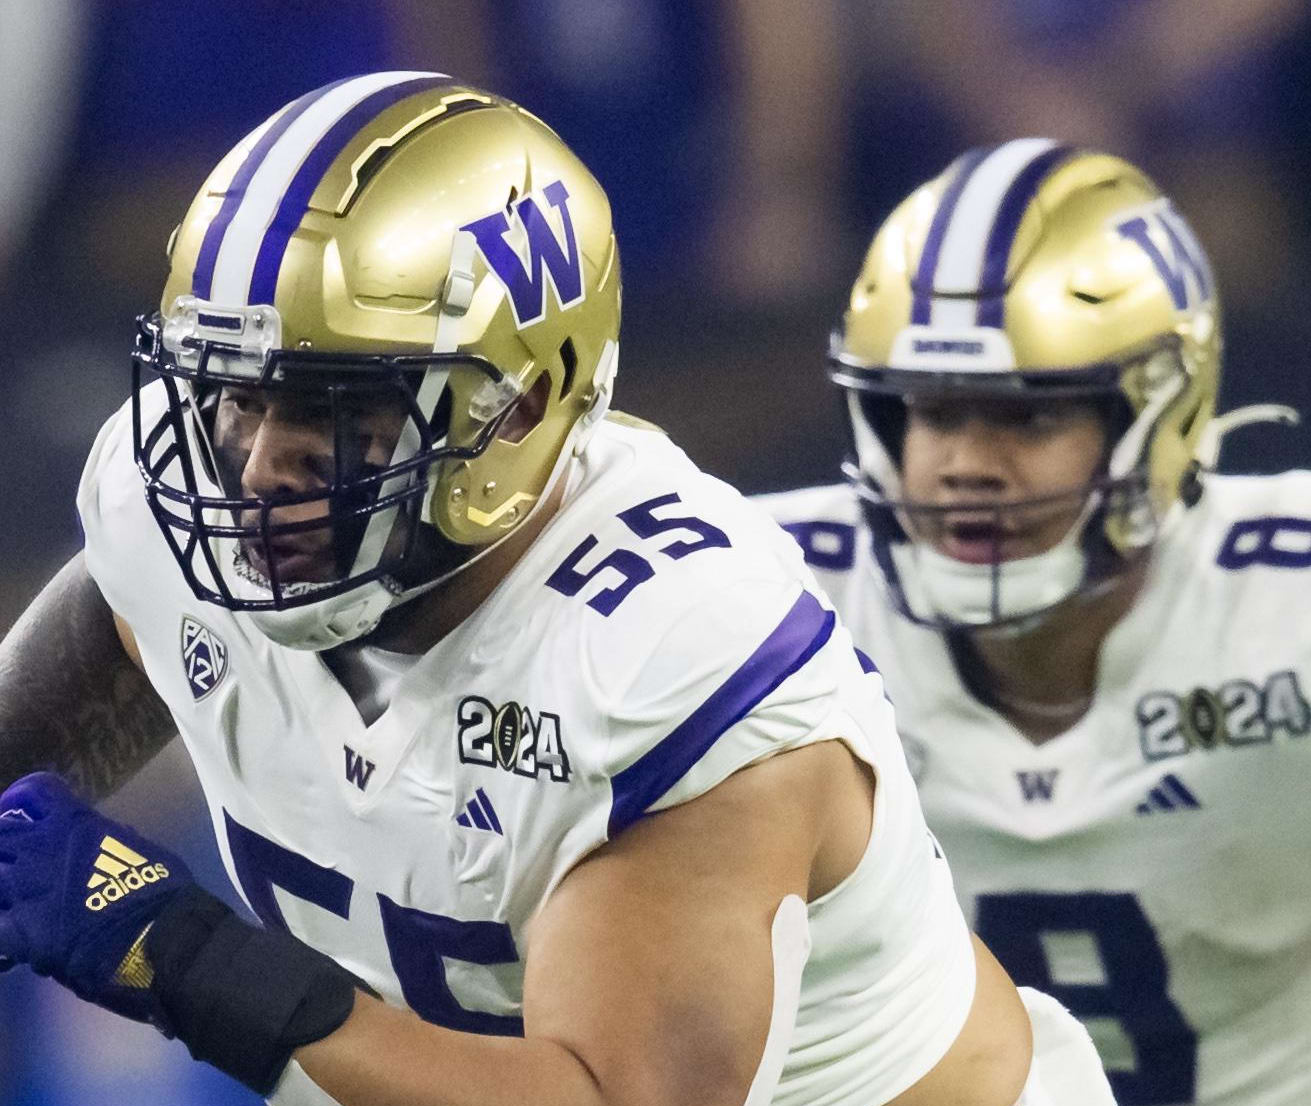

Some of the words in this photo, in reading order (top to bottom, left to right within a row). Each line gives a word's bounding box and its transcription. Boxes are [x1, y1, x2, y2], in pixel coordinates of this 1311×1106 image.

[458, 180, 586, 330] W
[544, 491, 732, 618] 55
[183, 618, 226, 681] PAC
[188, 652, 211, 691] 12
[343, 743, 377, 793] W
[1015, 768, 1060, 802] W
[85, 862, 170, 911] adidas
